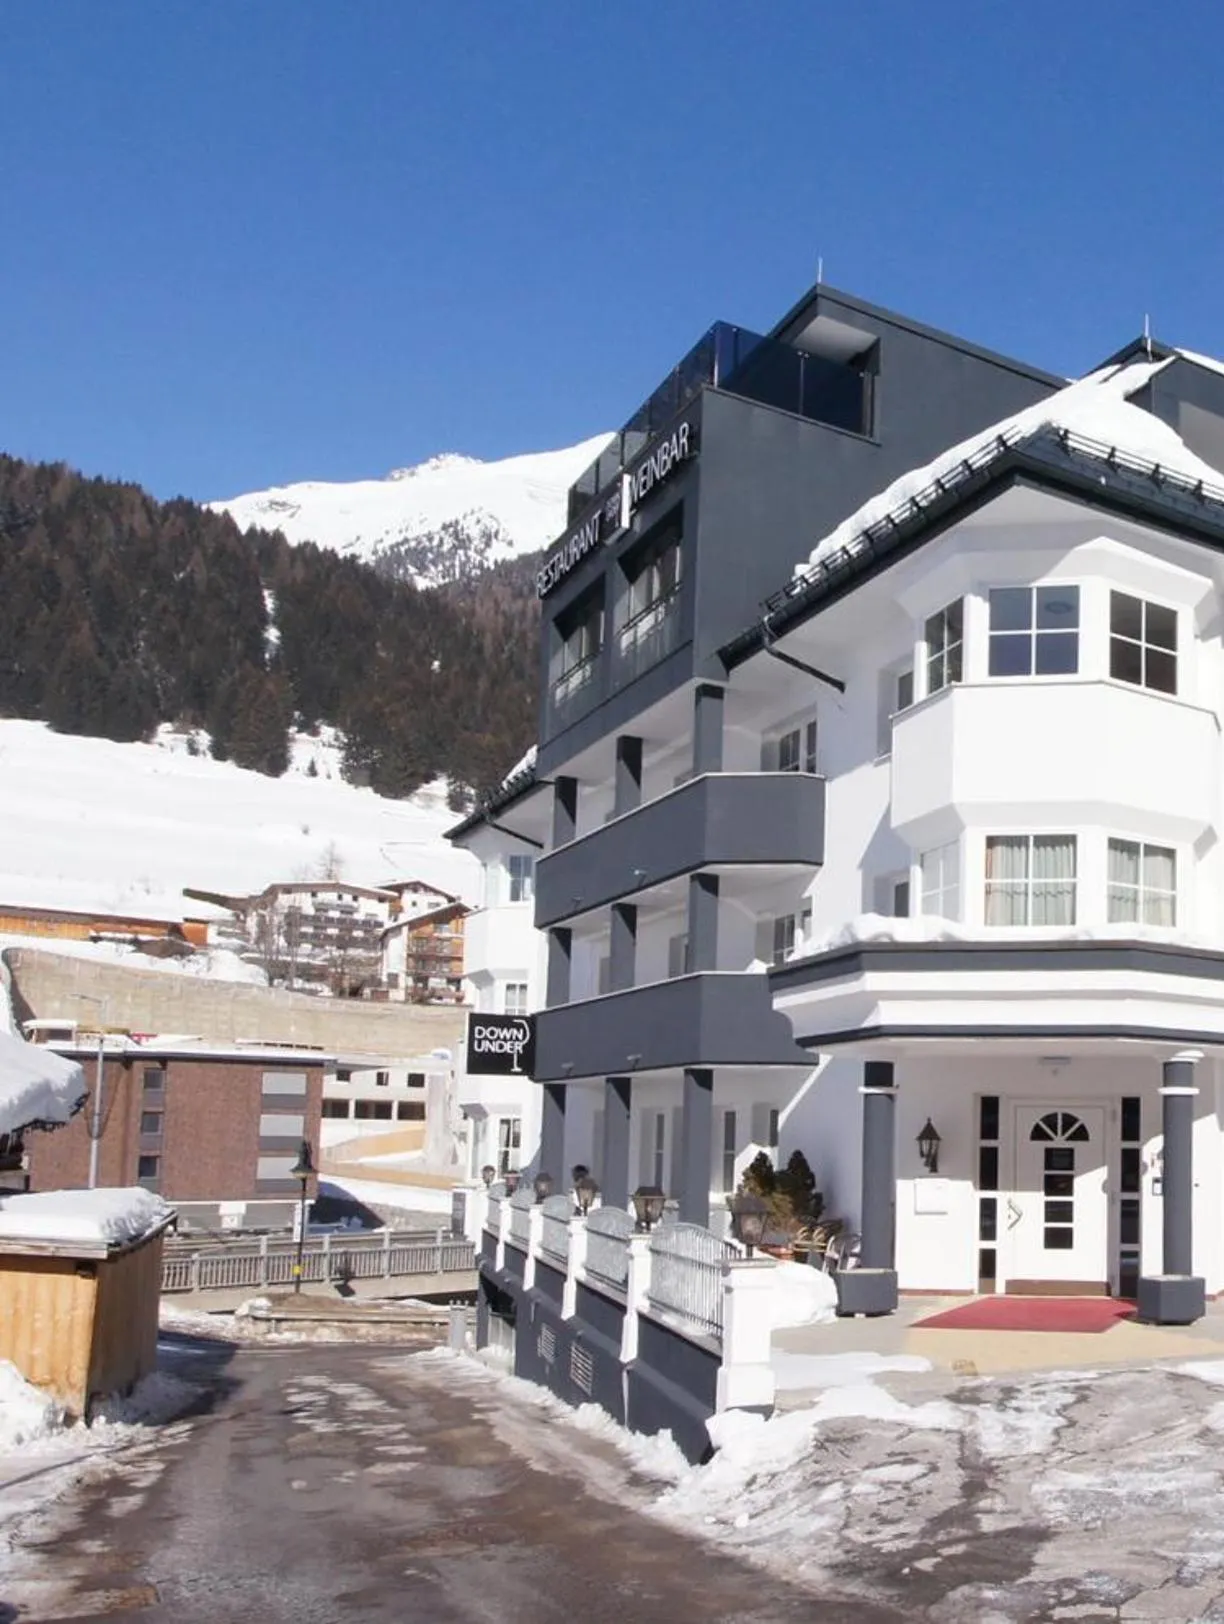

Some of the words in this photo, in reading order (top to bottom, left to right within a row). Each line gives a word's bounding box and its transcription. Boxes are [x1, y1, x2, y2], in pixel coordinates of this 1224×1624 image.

[536, 509, 602, 600] RESTAURANT
[474, 1026, 523, 1041] DOWN
[474, 1040, 524, 1054] UNDER
